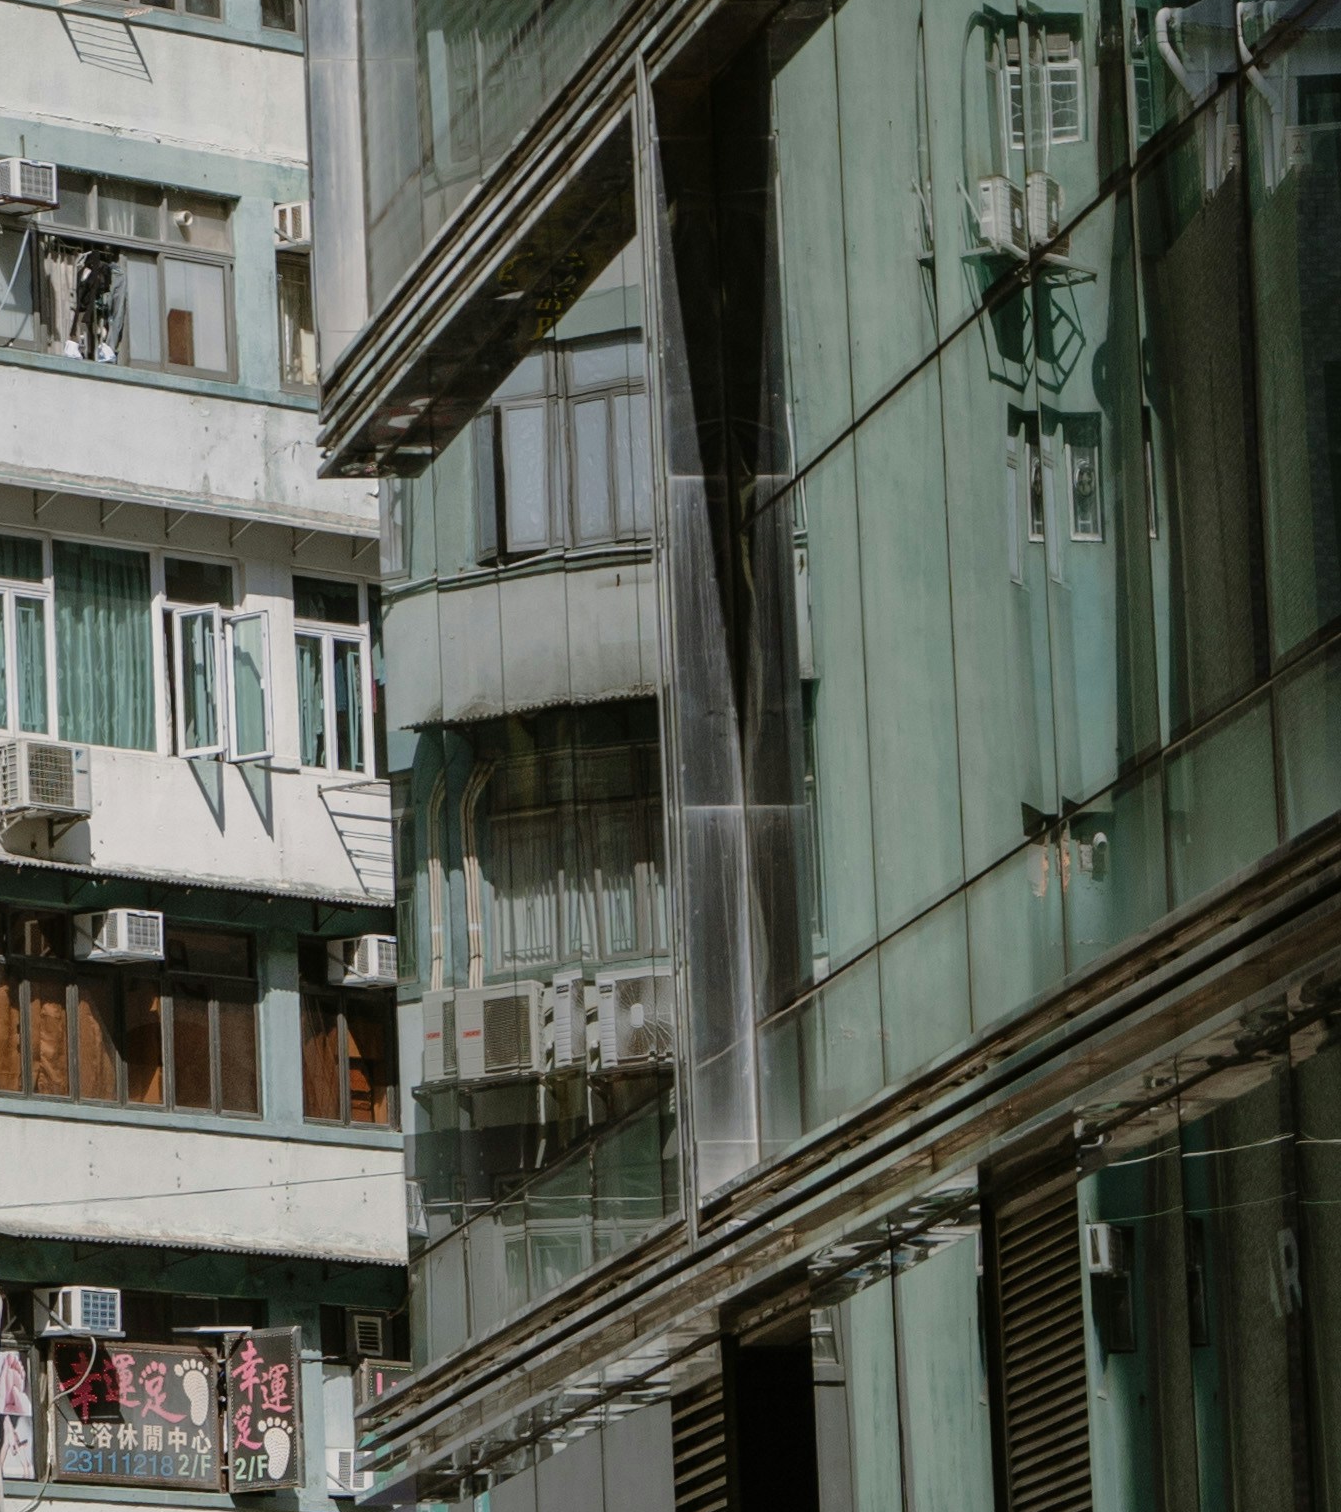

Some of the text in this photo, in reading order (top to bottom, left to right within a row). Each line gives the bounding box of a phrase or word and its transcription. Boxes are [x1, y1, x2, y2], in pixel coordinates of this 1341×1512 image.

[63, 1449, 212, 1478] 23111218 2/F
[234, 1454, 268, 1481] 2/F
